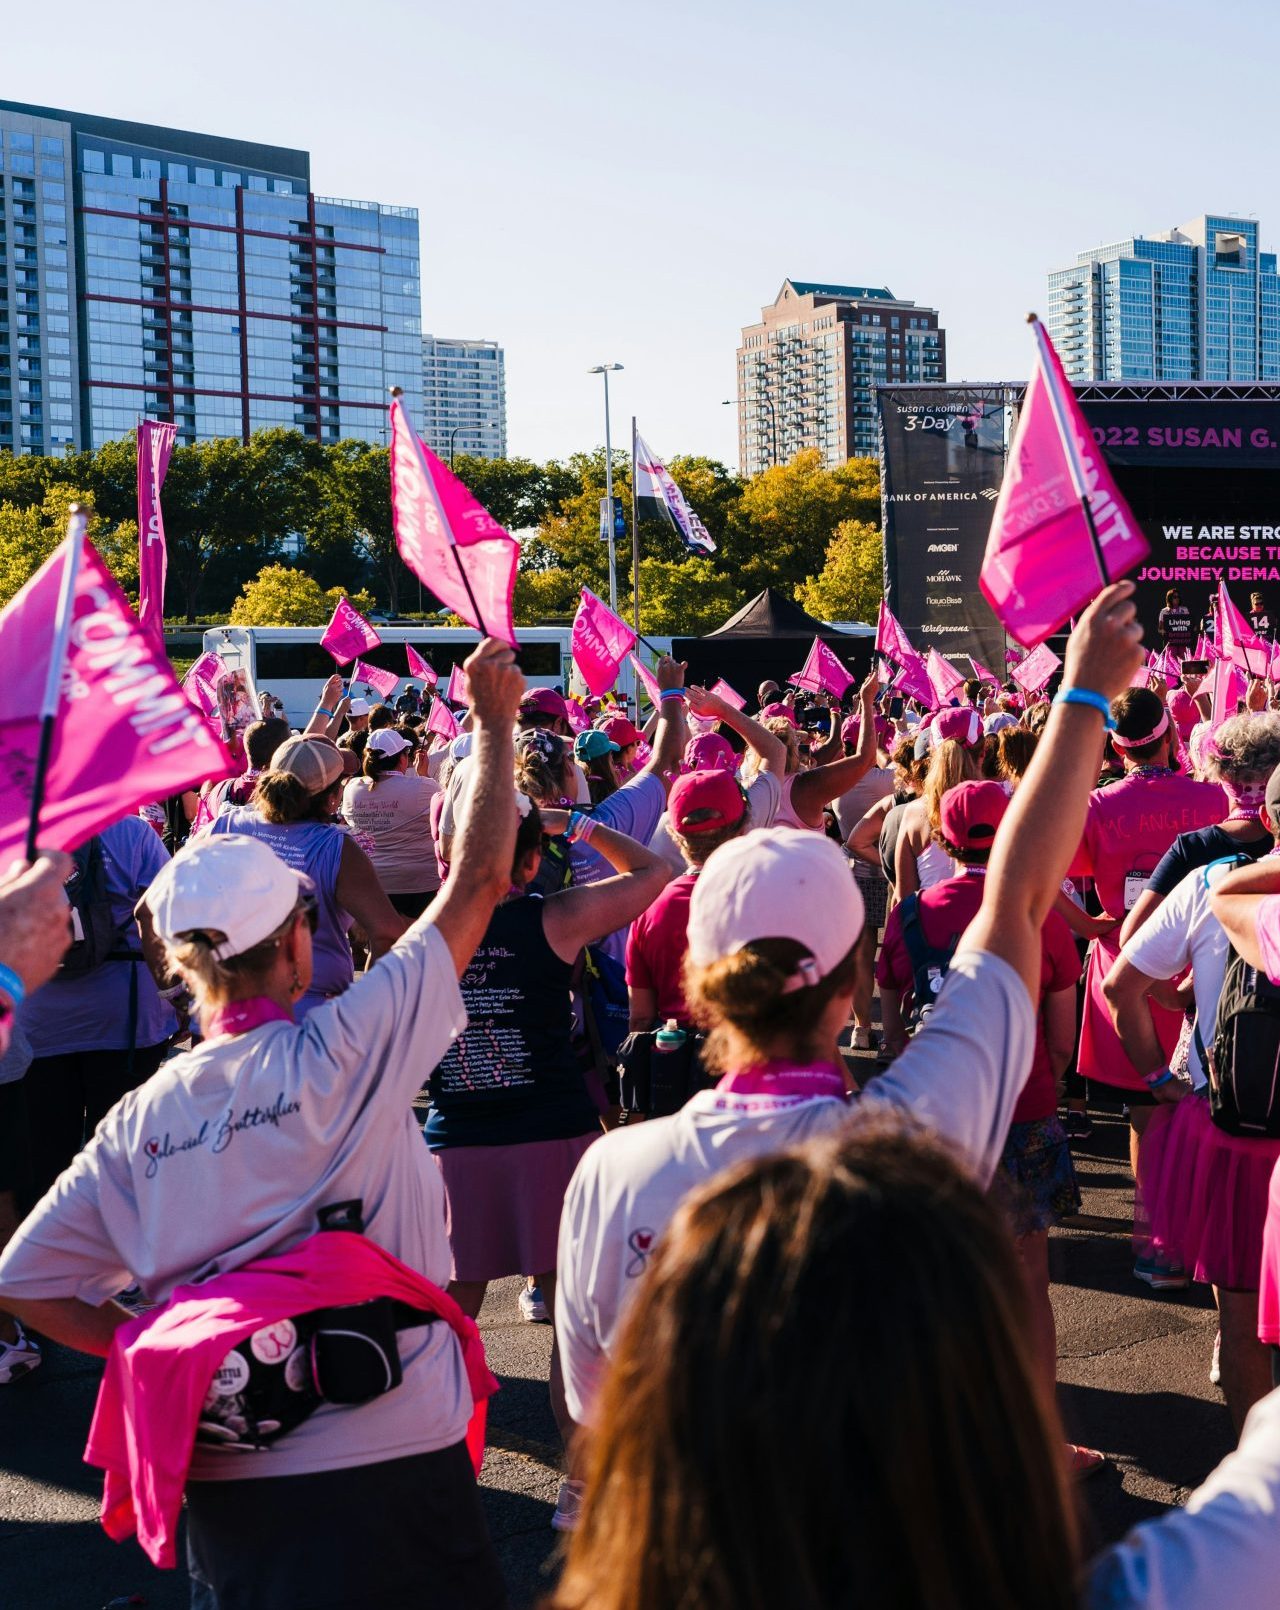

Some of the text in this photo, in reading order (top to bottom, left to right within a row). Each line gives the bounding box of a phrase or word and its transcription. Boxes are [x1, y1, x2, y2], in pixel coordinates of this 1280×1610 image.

[904, 416, 956, 431] 3-Day
[1092, 427, 1139, 446] 022
[1147, 427, 1242, 448] SUSAN
[1250, 428, 1277, 448] G.
[930, 493, 978, 501] AMERICA
[1162, 526, 1193, 540] WE
[1197, 526, 1235, 540] ARE
[928, 544, 958, 552] AMGEN
[1176, 546, 1261, 560] BECAUSE
[1137, 567, 1224, 581] JOURNEY
[340, 605, 377, 641] COMMIT
[1168, 619, 1190, 627] Living
[1250, 615, 1270, 629] 14
[921, 625, 970, 635] Walgreens
[212, 1092, 302, 1154] Butterflies
